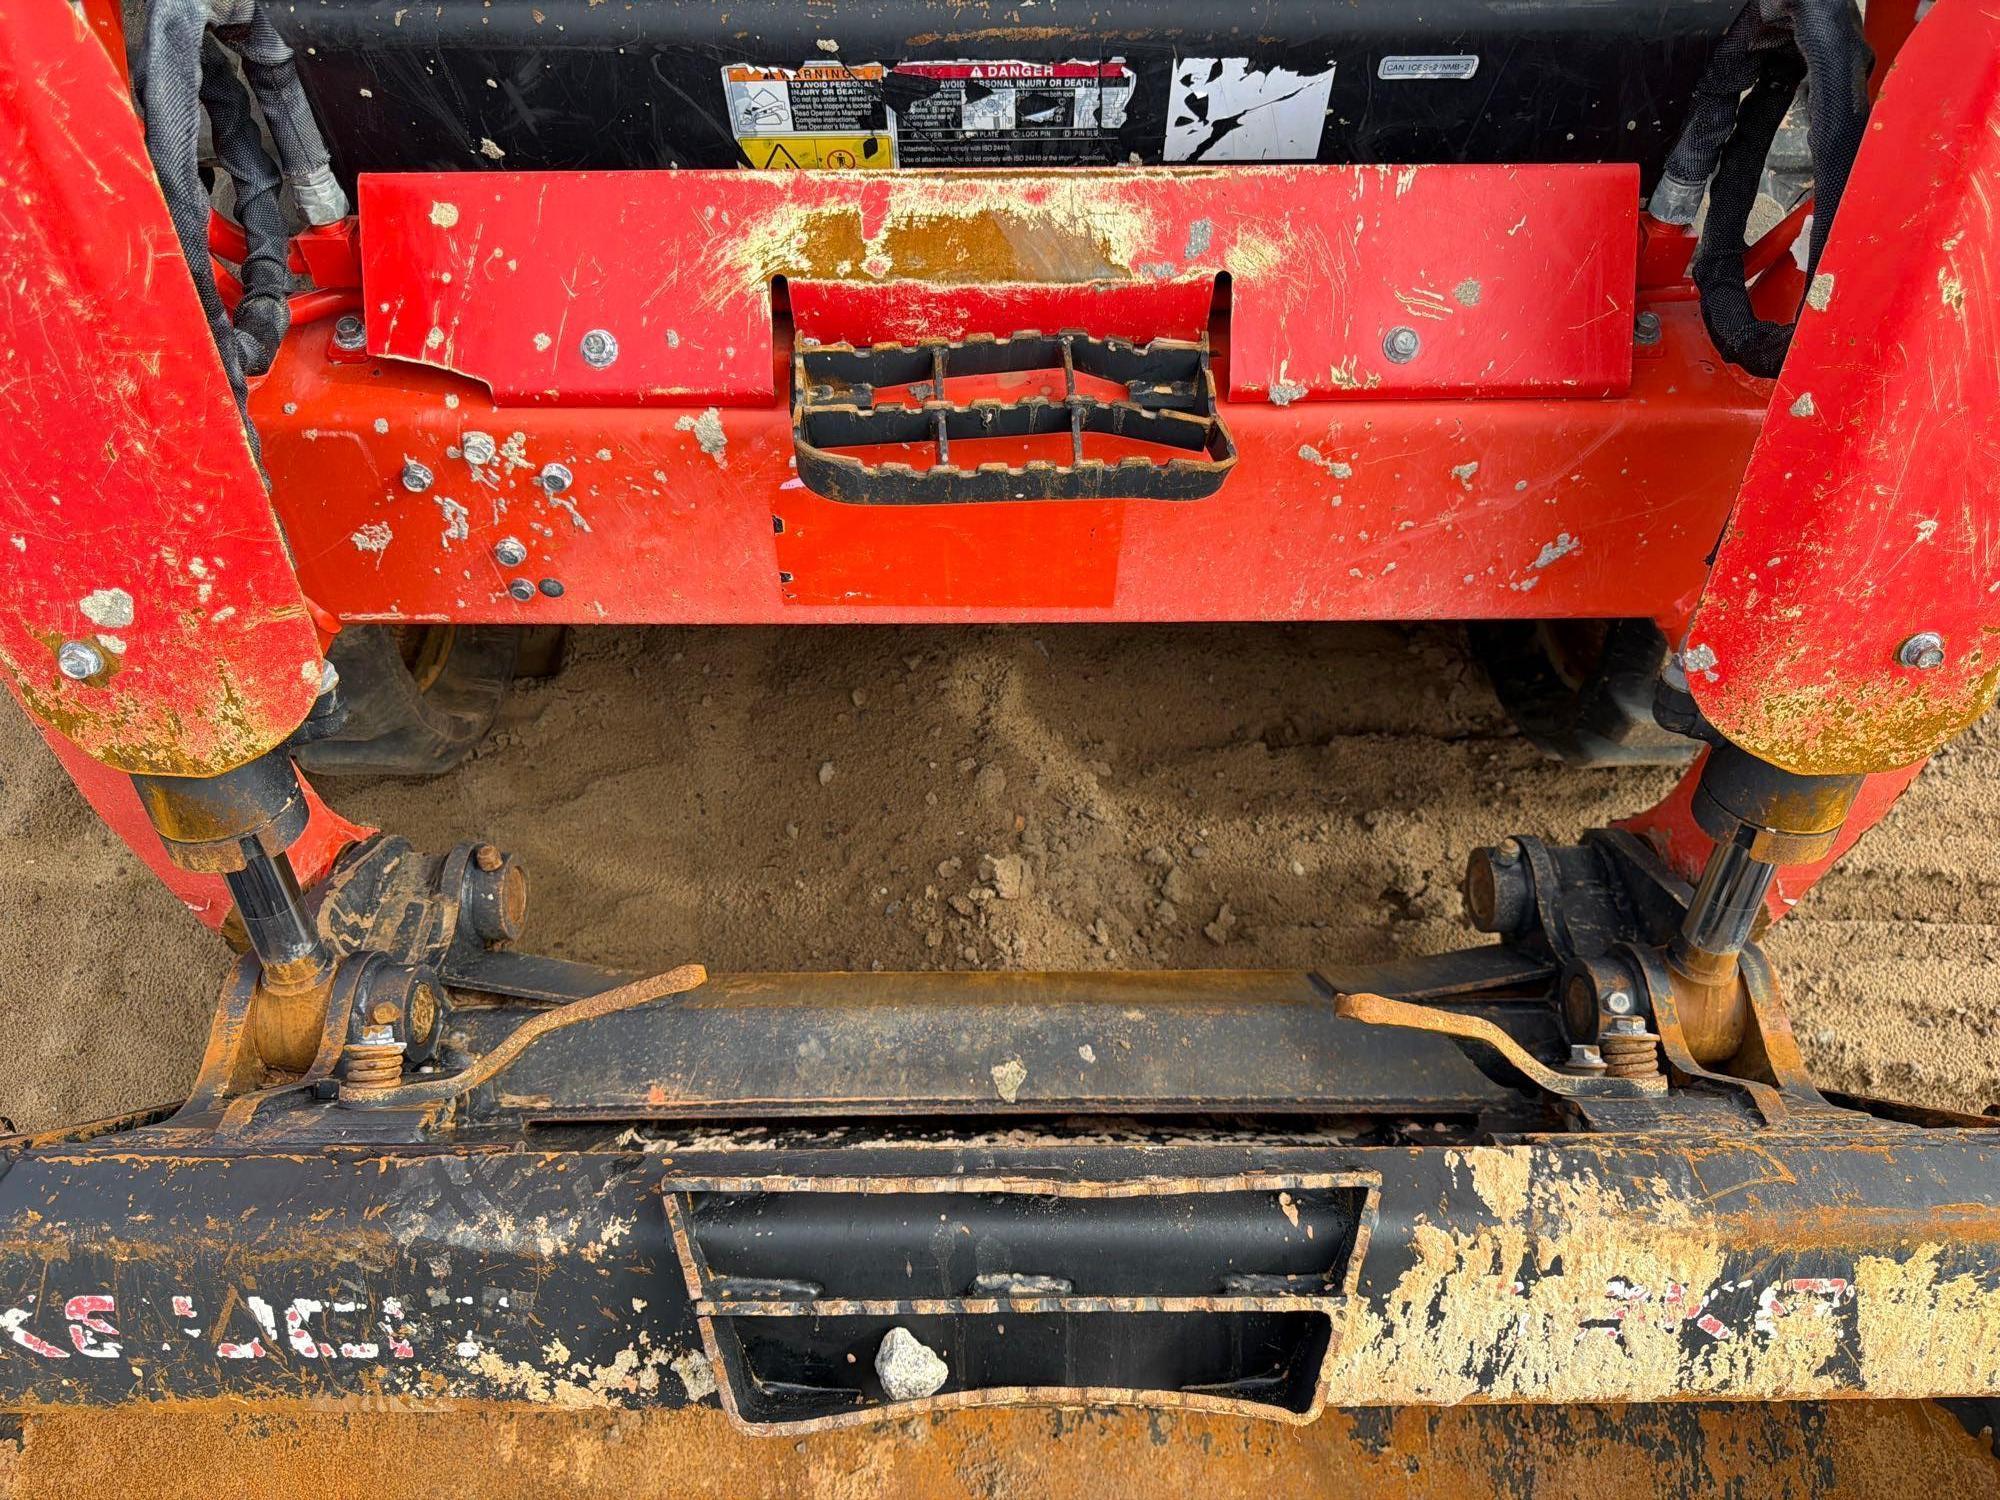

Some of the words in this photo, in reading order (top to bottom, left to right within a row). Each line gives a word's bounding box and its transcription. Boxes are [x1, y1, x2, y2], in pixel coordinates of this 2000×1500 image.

[987, 66, 1054, 77] DANGER
[940, 80, 966, 89] AVOID
[1016, 79, 1047, 88] INJURY
[1049, 79, 1061, 87] OR
